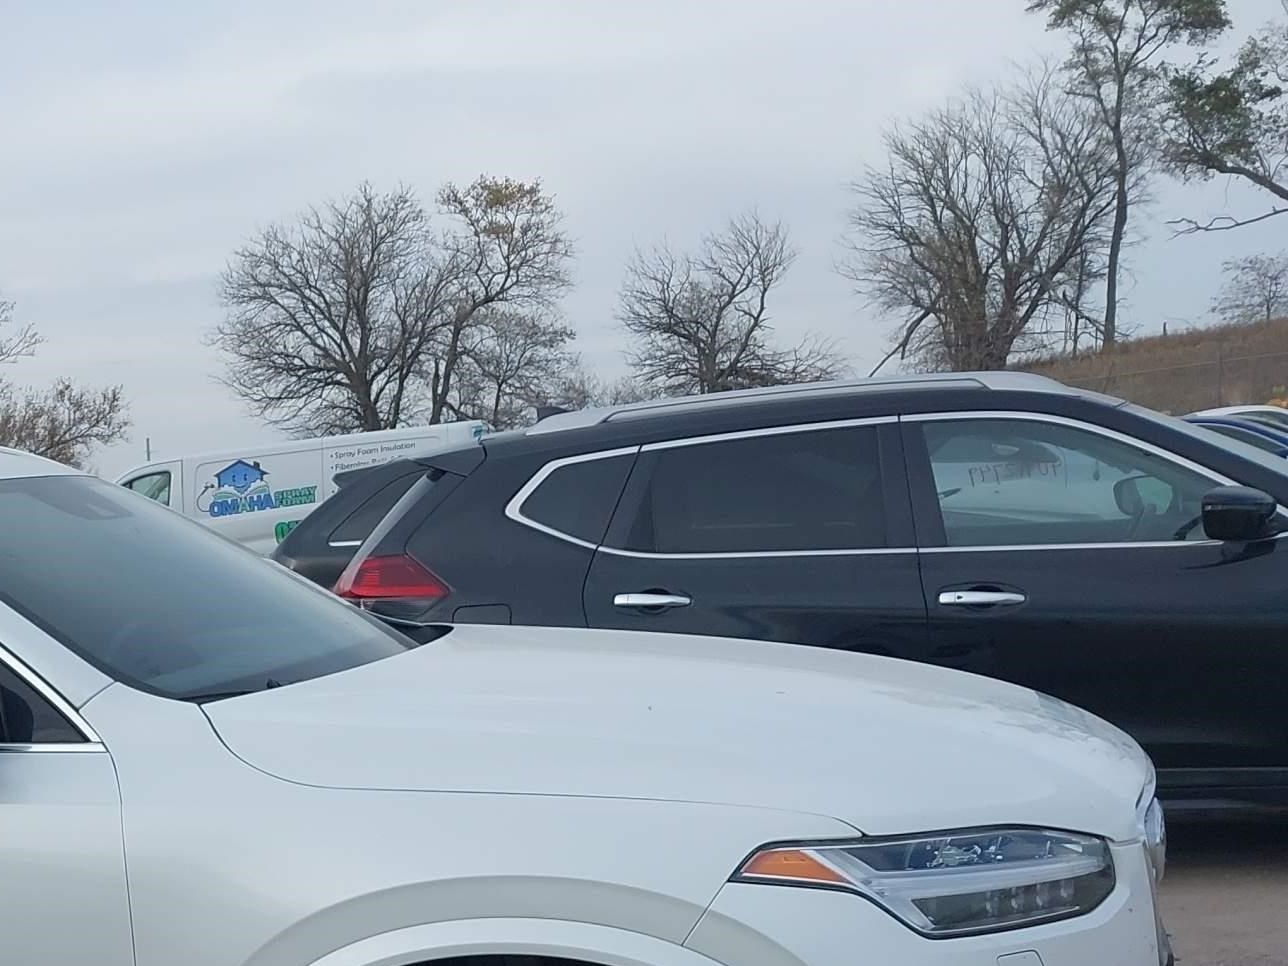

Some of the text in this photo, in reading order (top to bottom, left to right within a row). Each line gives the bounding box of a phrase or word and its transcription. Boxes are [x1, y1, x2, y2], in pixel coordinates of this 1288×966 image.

[334, 442, 416, 460] Spray Foam Insulation
[274, 486, 317, 500] SPRAY
[209, 494, 274, 517] OMAHA
[274, 495, 316, 508] FOAM
